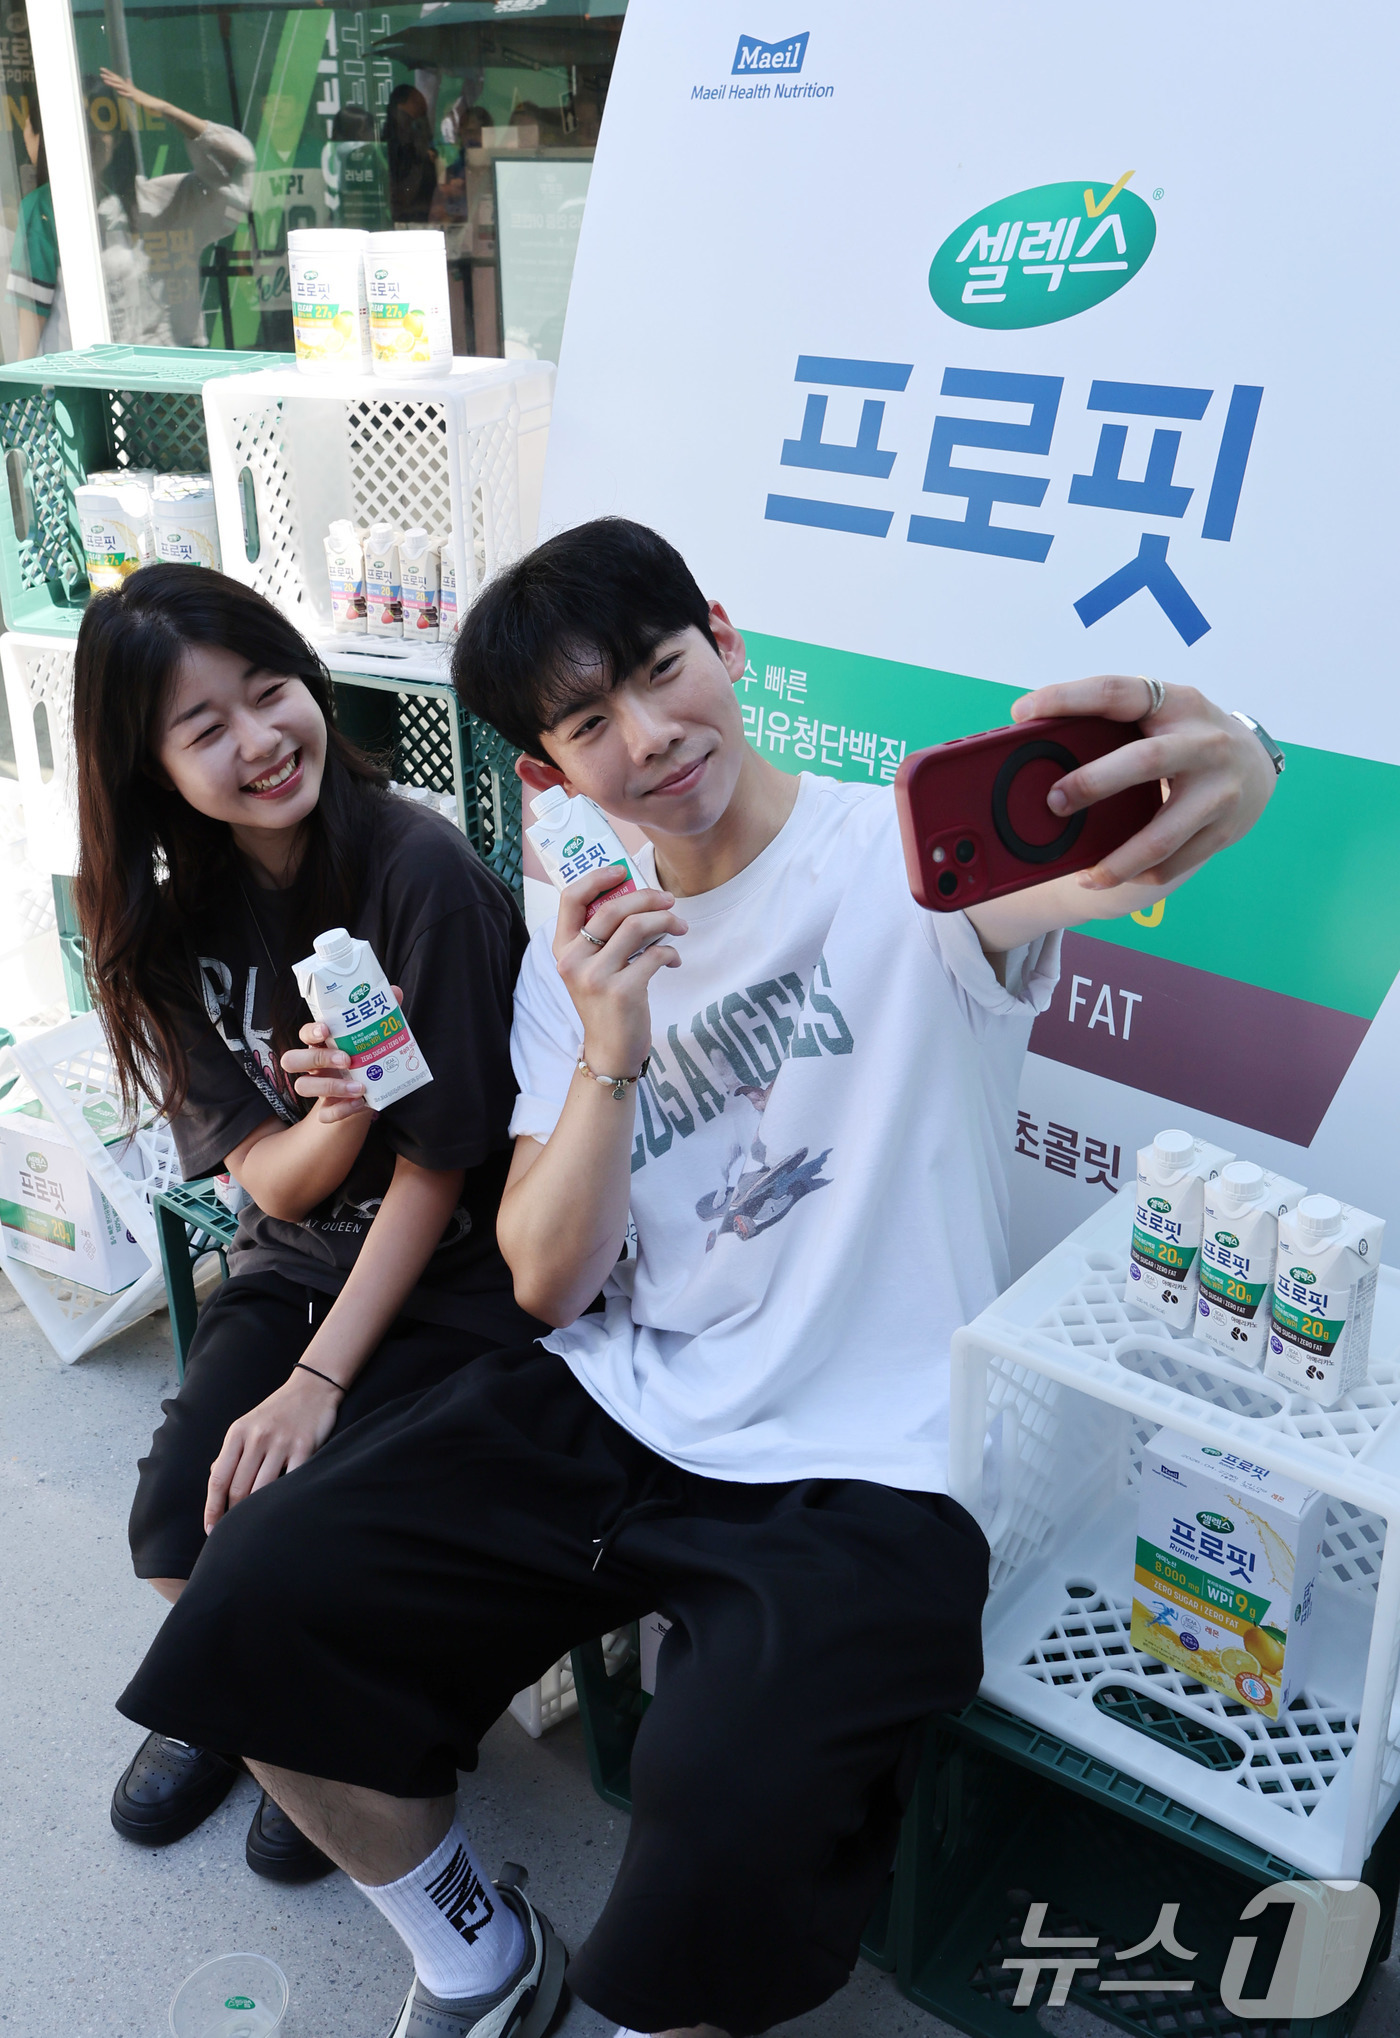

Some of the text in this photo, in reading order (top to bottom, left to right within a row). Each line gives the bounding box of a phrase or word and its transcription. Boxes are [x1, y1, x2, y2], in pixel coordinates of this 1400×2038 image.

[737, 43, 801, 69] Maeil
[691, 82, 834, 100] Maeil Health Nutrition
[955, 213, 1129, 304] 셀렉스
[764, 354, 1264, 648] 프로핏
[740, 659, 808, 704] 수 빠른
[741, 704, 907, 782] 리유청단백질
[559, 843, 610, 884] 프로핏
[342, 991, 390, 1028] 프로핏
[1068, 974, 1142, 1041] FAT
[1015, 1110, 1121, 1194] 초콜릿
[19, 1170, 66, 1215] 프로핏
[321, 1221, 362, 1234] QUEEN
[1136, 1204, 1181, 1244] 프로핏
[1158, 1244, 1183, 1267] 20g
[1203, 1238, 1250, 1280] 프로핏
[1226, 1279, 1252, 1303] 20g
[1277, 1274, 1328, 1317] 프로핏
[1301, 1316, 1329, 1340] 20g
[1221, 1453, 1270, 1481] 프로핏
[1200, 1513, 1232, 1532] 셀렉스
[1169, 1517, 1256, 1584] 프로핏
[1169, 1542, 1199, 1561] Runner
[1154, 1580, 1239, 1629] ZERO SUGAR ZERO FAT
[1207, 1585, 1233, 1608] WPI
